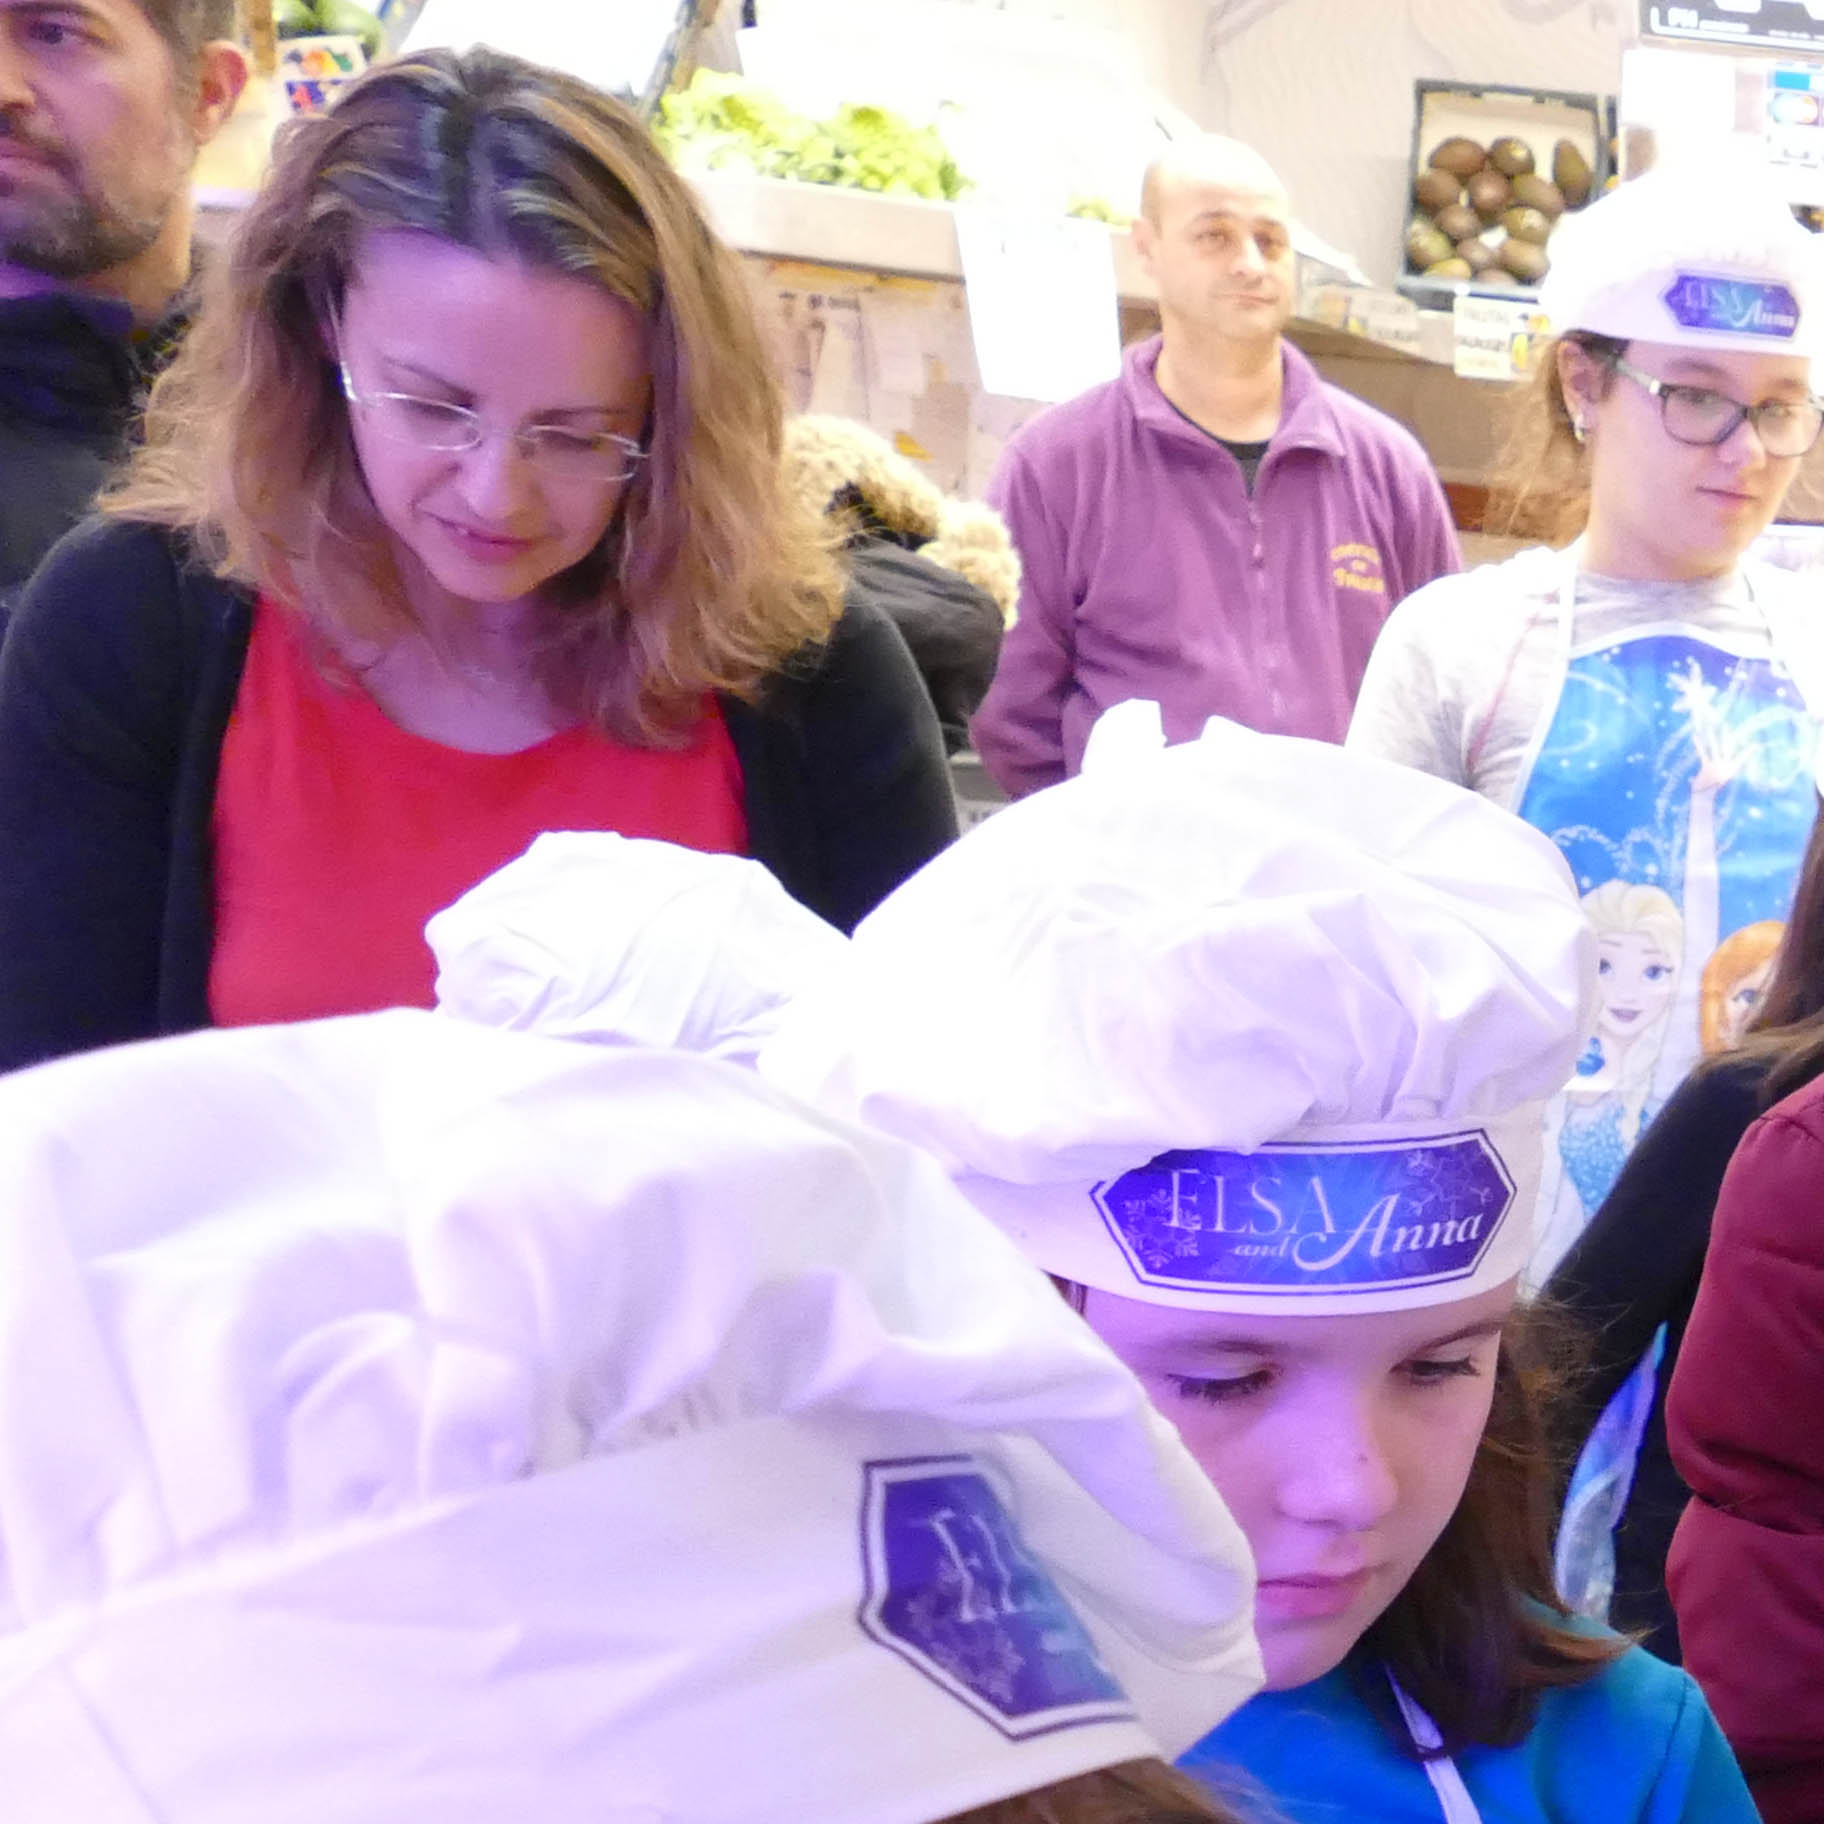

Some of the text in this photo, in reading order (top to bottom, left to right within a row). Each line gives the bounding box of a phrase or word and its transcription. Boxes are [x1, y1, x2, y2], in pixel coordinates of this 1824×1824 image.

[1164, 1167, 1338, 1235] ELSA
[1232, 1192, 1485, 1272] and Anna
